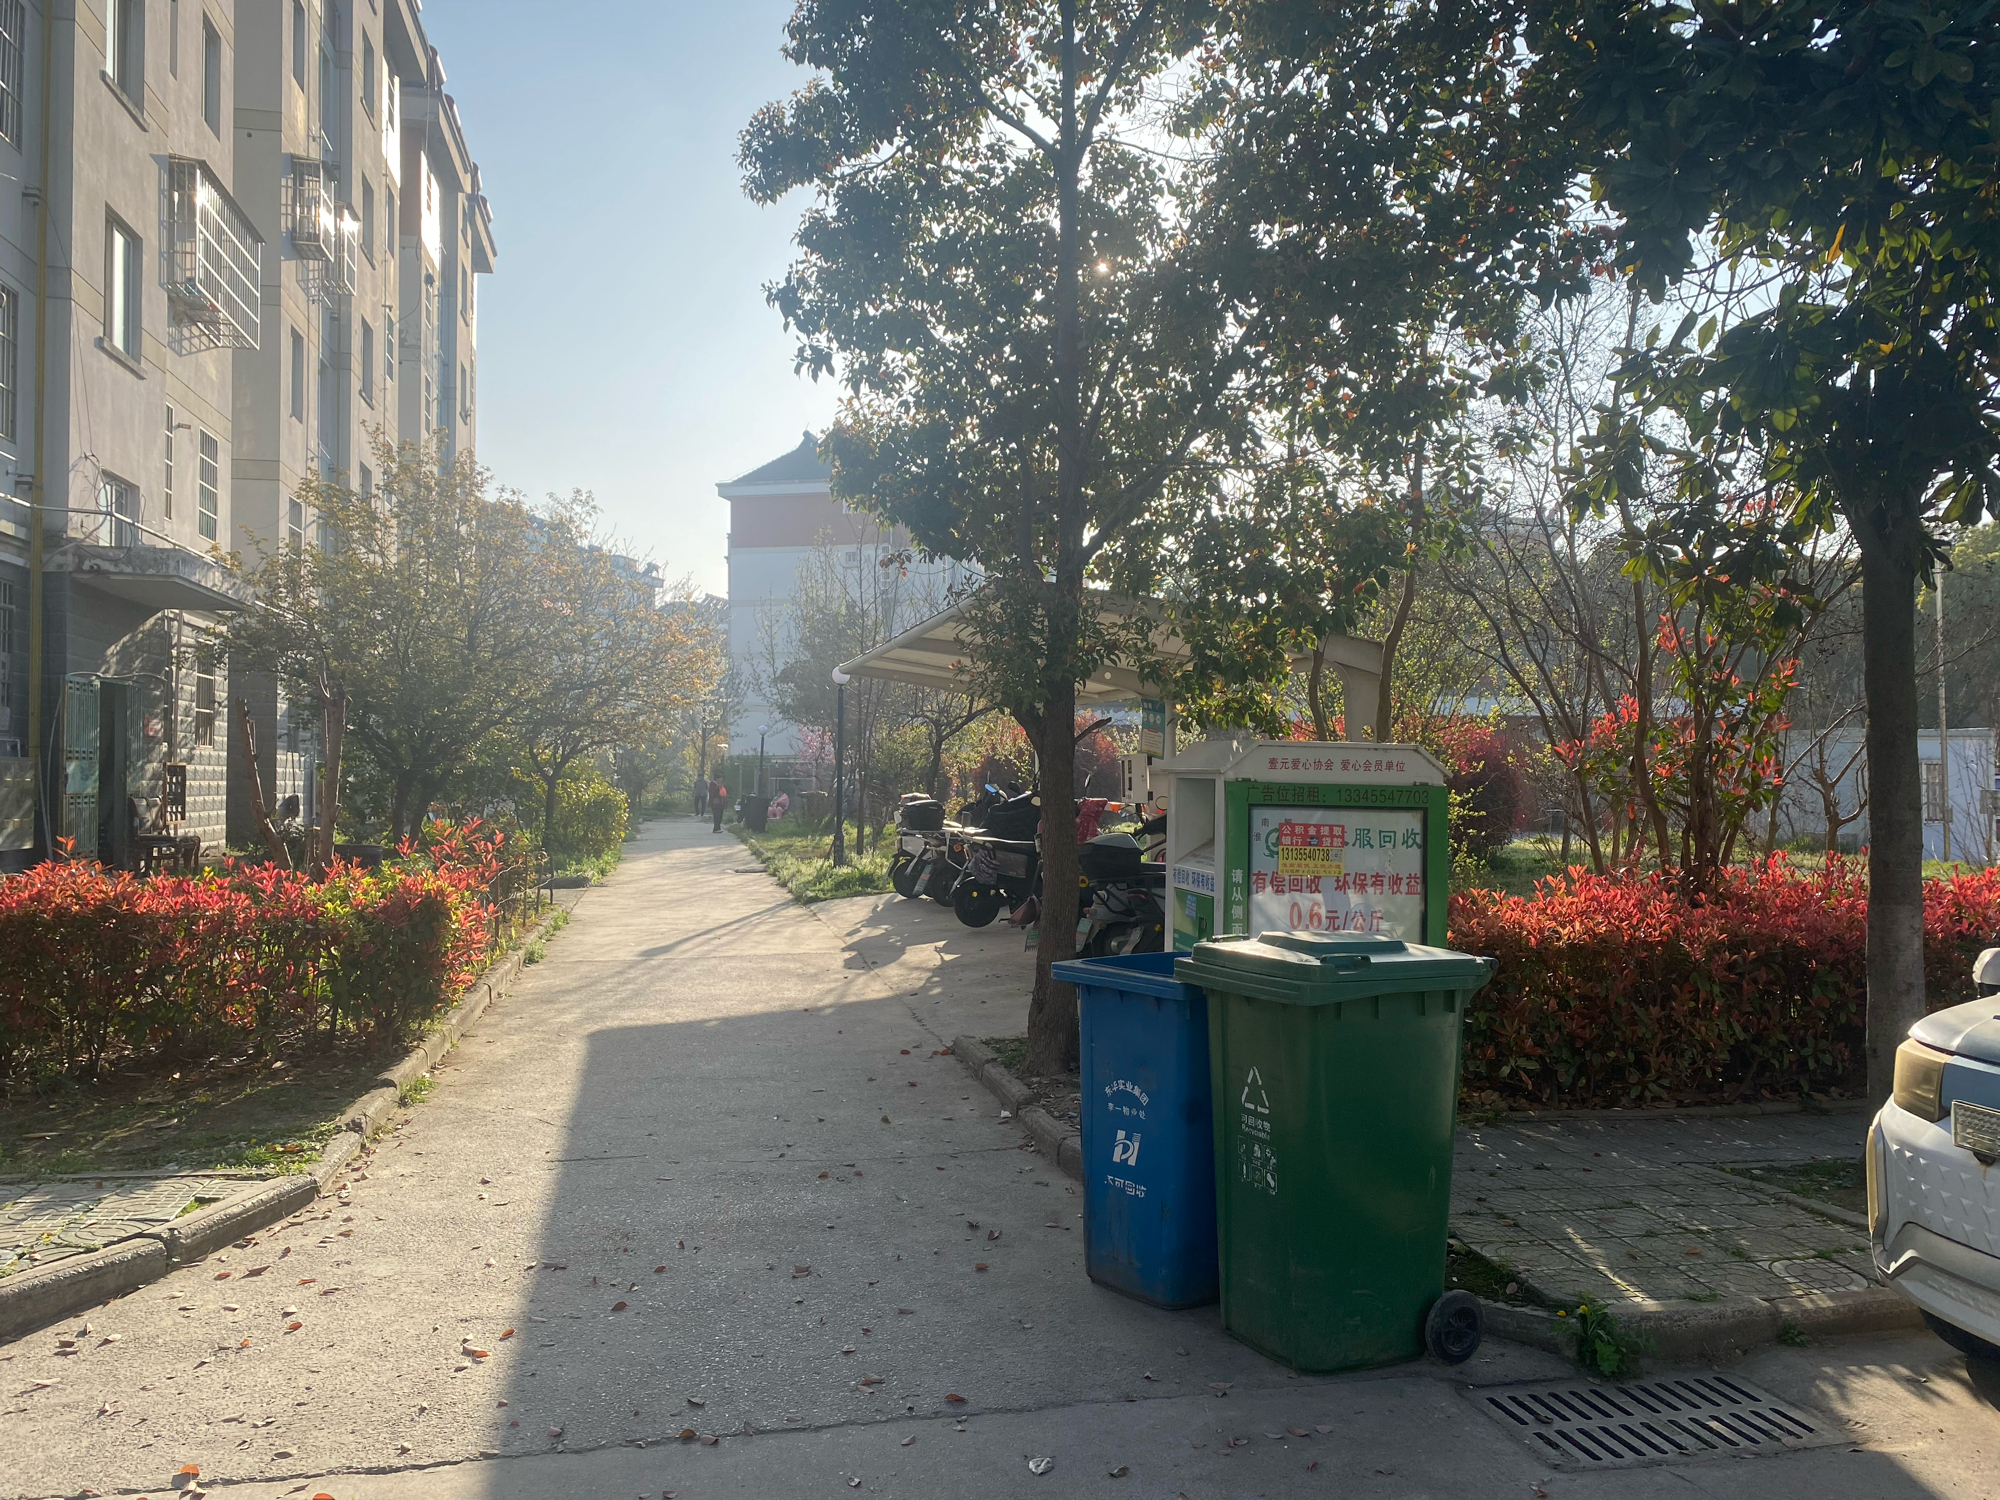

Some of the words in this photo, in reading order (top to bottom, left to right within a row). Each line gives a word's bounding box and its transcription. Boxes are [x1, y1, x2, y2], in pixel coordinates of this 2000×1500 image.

[1268, 757, 1334, 771] 壹元爱心协会
[1340, 758, 1406, 772] 爱心会员单位
[1336, 788, 1429, 804] 13345547703
[1281, 825, 1343, 836] 公积金提取
[1281, 835, 1303, 846] 银行
[1322, 836, 1343, 847] 贷款
[1344, 827, 1423, 850] 服回收
[1281, 847, 1330, 862] 13135540738
[1252, 870, 1322, 895] 有偿回收
[1334, 871, 1421, 896] 环保有收益
[1231, 869, 1243, 935] 请从侧面
[1289, 901, 1384, 932] 0.6元/公斤
[1104, 1079, 1150, 1106] 东华实业集团
[1241, 1113, 1271, 1133] 可回收物
[1104, 1174, 1147, 1198] 不可回收
